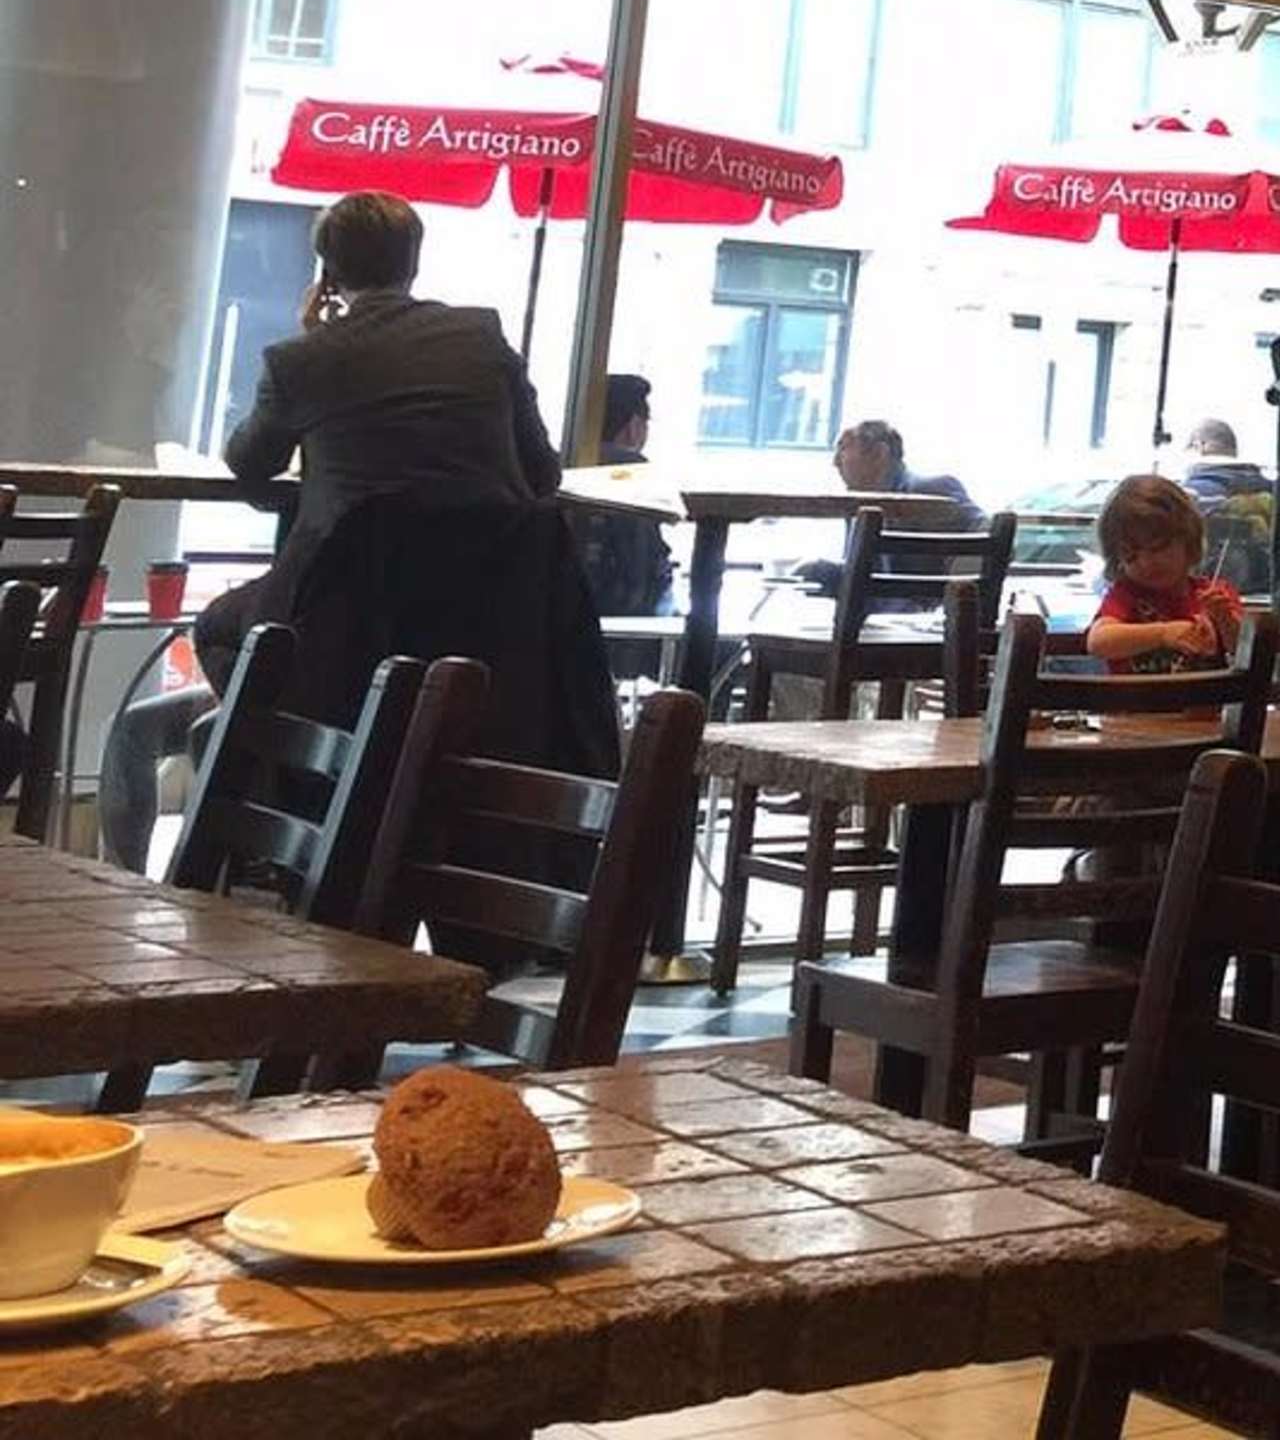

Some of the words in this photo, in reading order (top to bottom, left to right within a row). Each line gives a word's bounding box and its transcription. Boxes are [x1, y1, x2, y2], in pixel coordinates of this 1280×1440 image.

[311, 111, 411, 153] Caffè
[416, 115, 581, 159] Artigiano
[702, 145, 820, 194] Artigiano
[1013, 172, 1096, 210] Caffè
[1101, 176, 1237, 213] Artigiano
